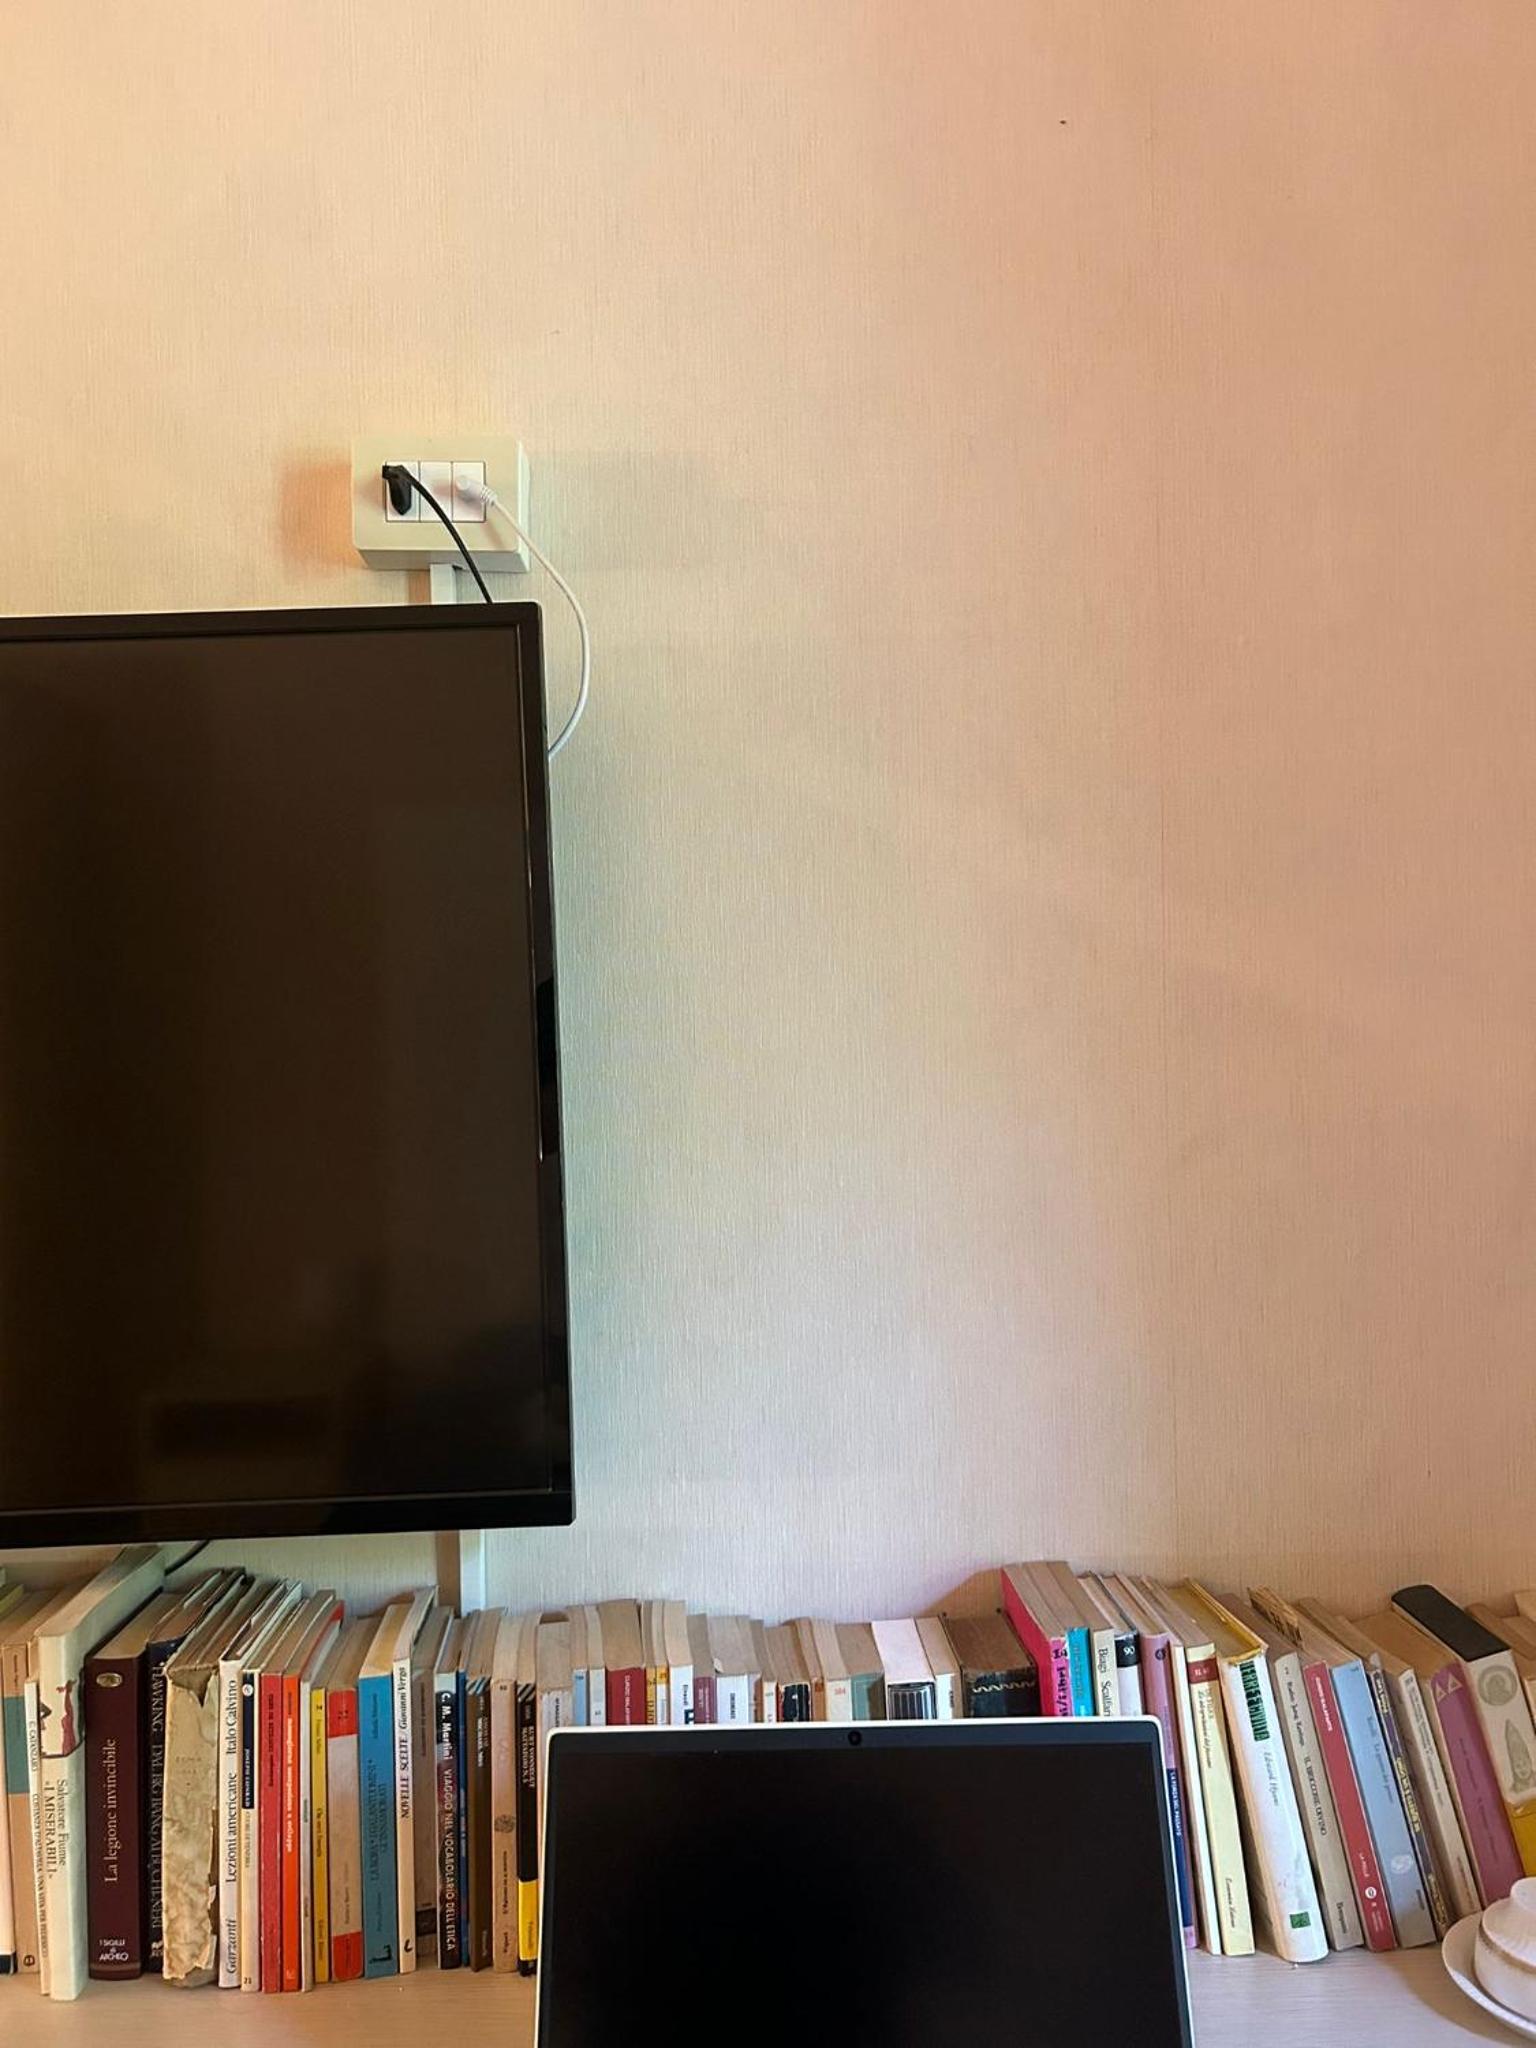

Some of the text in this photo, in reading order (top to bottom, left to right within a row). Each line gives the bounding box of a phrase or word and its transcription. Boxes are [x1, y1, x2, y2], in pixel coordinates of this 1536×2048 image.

[397, 1691, 408, 1730] Giovanni
[441, 1692, 450, 1702] C.
[441, 1706, 451, 1719] M.
[399, 1738, 409, 1771] SCELTE
[442, 1723, 453, 1760] Martini
[225, 1679, 238, 1883] Lezioni americane Italo Calvino
[400, 1776, 410, 1818] NOVELLE
[443, 1769, 453, 1810] VIAGGIO
[57, 1779, 69, 1865] Salvatore Fiume
[102, 1738, 121, 1882] La legione invincibile
[444, 1813, 453, 1830] NEL
[444, 1833, 454, 1900] VOCABOLARIO
[225, 1918, 238, 1974] Garzanti
